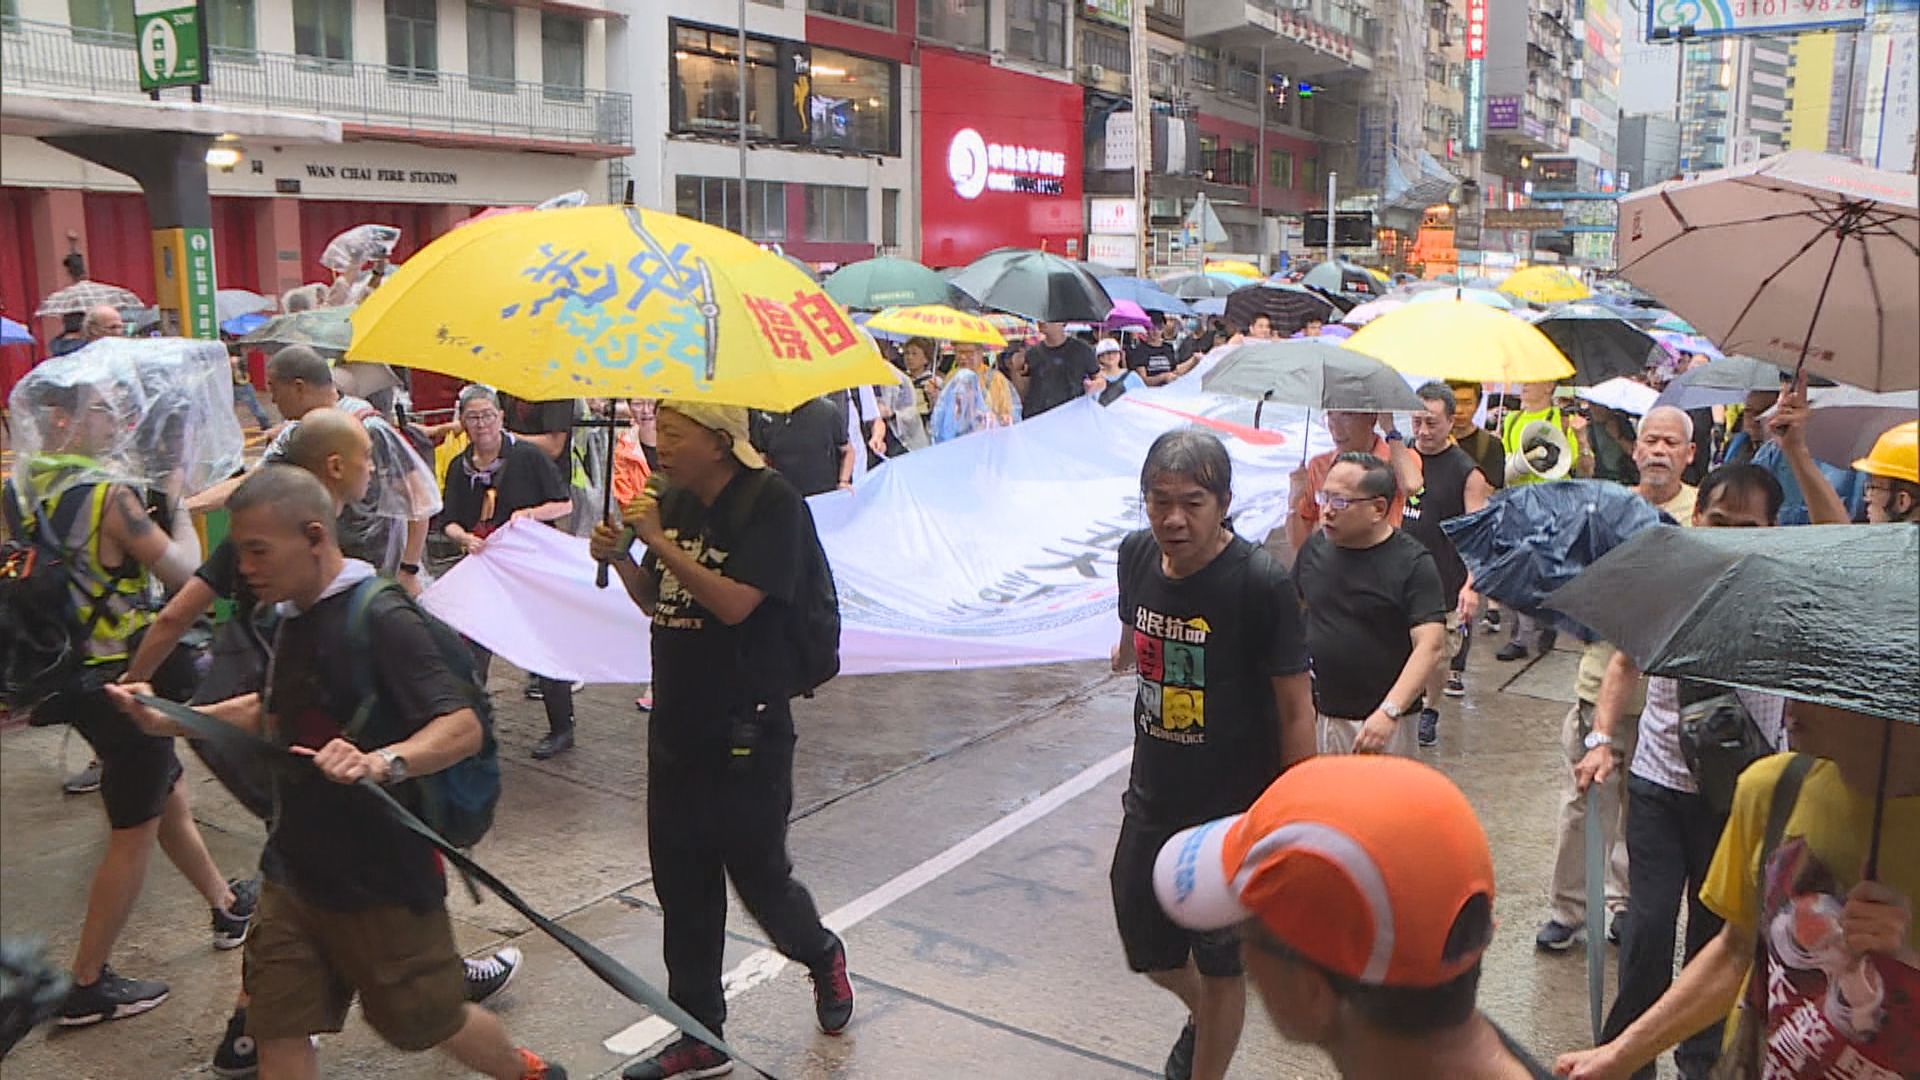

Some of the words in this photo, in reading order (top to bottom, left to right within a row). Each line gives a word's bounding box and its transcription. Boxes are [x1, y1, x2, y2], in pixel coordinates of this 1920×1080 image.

[306, 164, 335, 178] WAN
[340, 168, 372, 182] CHAI
[377, 169, 404, 182] FIRE
[409, 171, 458, 185] STATION
[1136, 605, 1211, 644] 公民抗命
